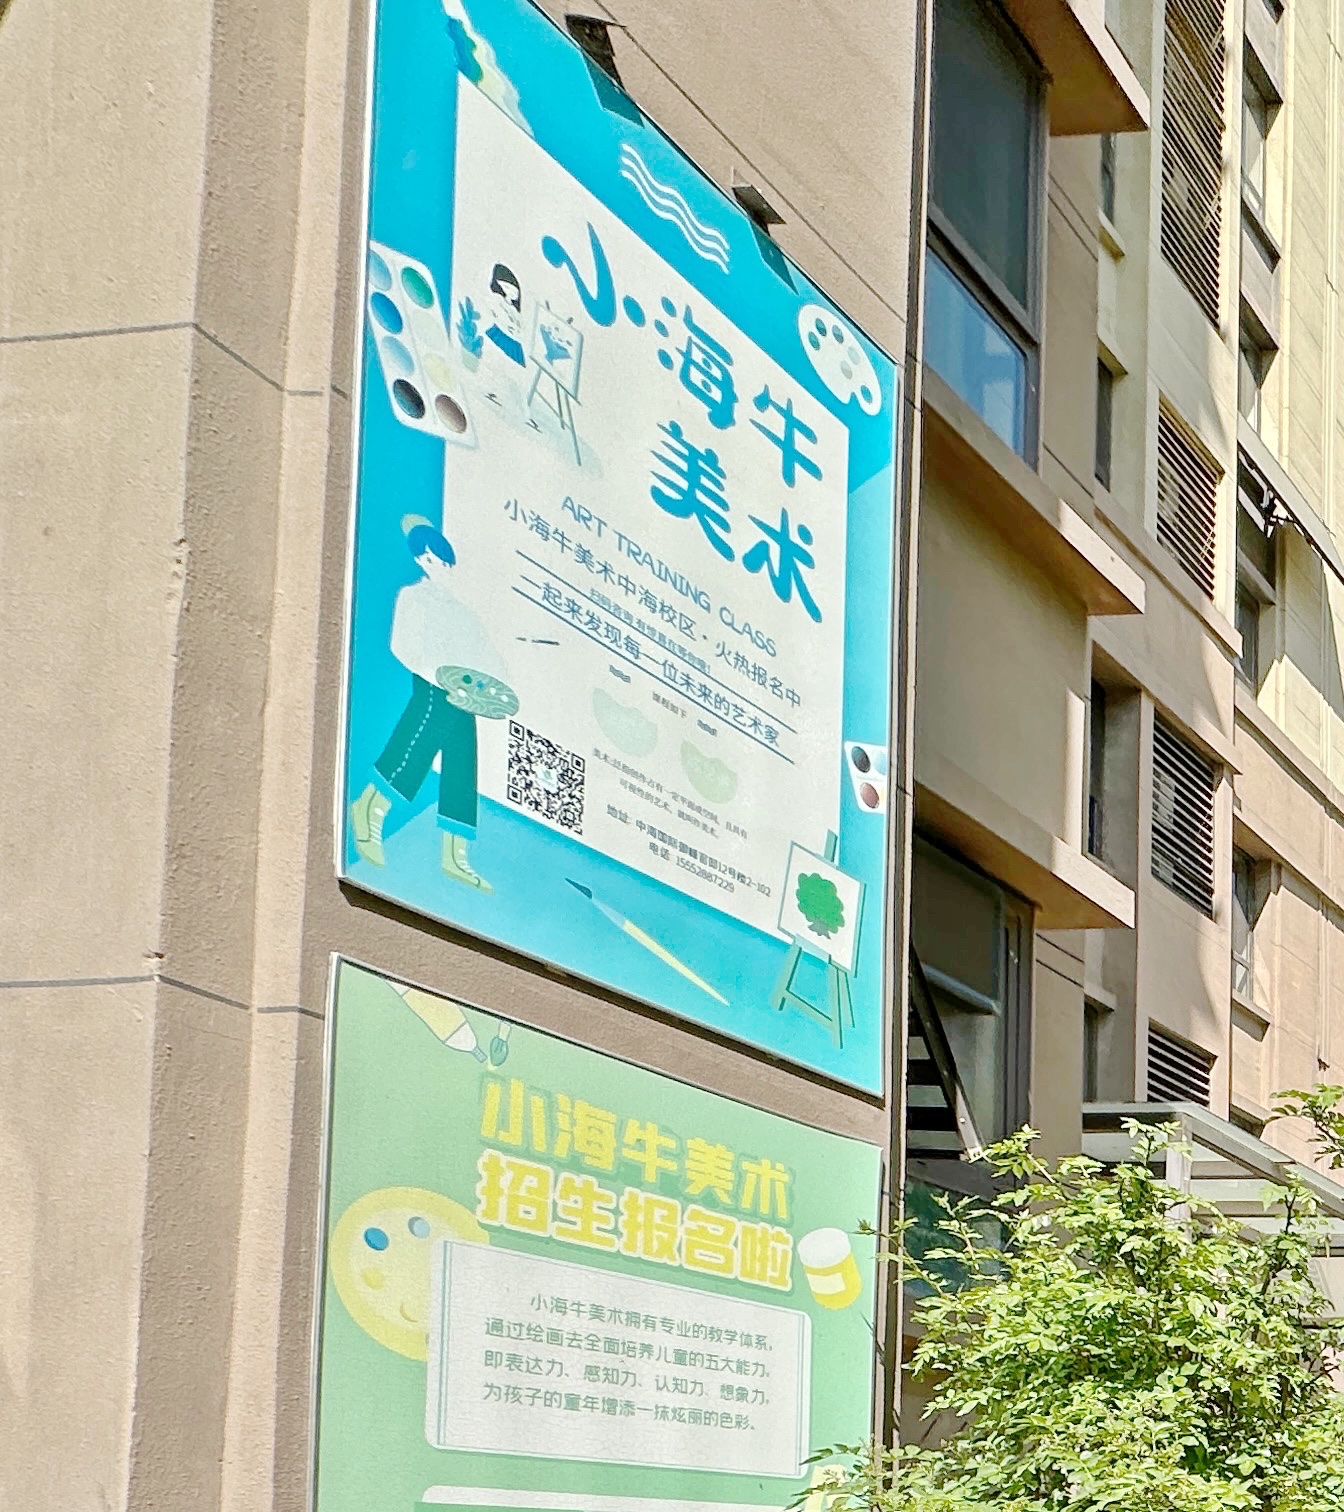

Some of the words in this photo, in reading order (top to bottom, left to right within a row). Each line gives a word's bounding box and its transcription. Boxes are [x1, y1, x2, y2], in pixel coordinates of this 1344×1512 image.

[540, 221, 822, 490] 小海牛
[561, 496, 607, 538] ART
[613, 529, 711, 614] TRAINING
[719, 606, 777, 658] CLASS
[650, 420, 821, 623] 美术
[519, 574, 780, 748] 一起来发现每一位未来的艺术家
[477, 1150, 792, 1291] 招生报名啦
[480, 1078, 790, 1221] 小海牛美术
